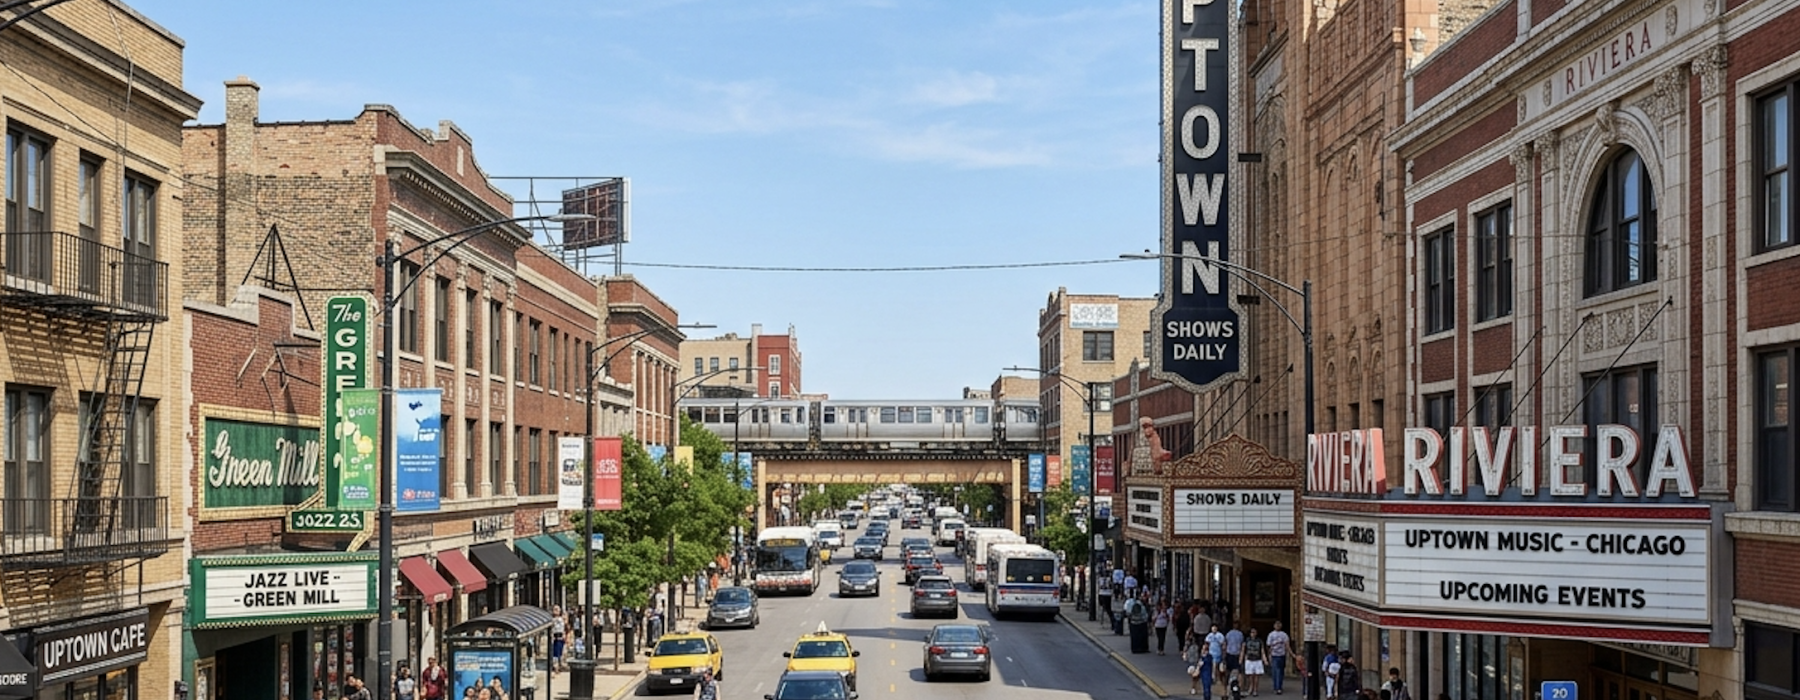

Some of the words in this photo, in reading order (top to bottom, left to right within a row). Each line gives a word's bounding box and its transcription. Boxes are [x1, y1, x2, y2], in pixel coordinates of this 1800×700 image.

[1566, 21, 1652, 95] RIVIERA
[332, 302, 361, 322] The
[1166, 321, 1234, 338] SHOWS
[1173, 343, 1227, 360] DAILY
[208, 429, 274, 488] Green
[275, 437, 320, 487] Mill
[1307, 427, 1384, 495] RIVIERA
[1403, 424, 1697, 498] RIVIERA
[1186, 493, 1236, 505] SHOWS
[1241, 493, 1281, 506] DAILY
[1405, 529, 1489, 550] UPTOWN
[1498, 531, 1563, 552] MUSIC
[1586, 533, 1686, 555] CHICAGO
[245, 572, 287, 589] JAZZ
[294, 571, 329, 588] LIVE
[303, 589, 340, 606] MILL
[1440, 580, 1549, 604] UPCOMING
[1558, 585, 1646, 609] EVENTS
[43, 630, 108, 669] UPTOWN
[110, 622, 146, 653] CAFE
[1552, 687, 1568, 699] 20
